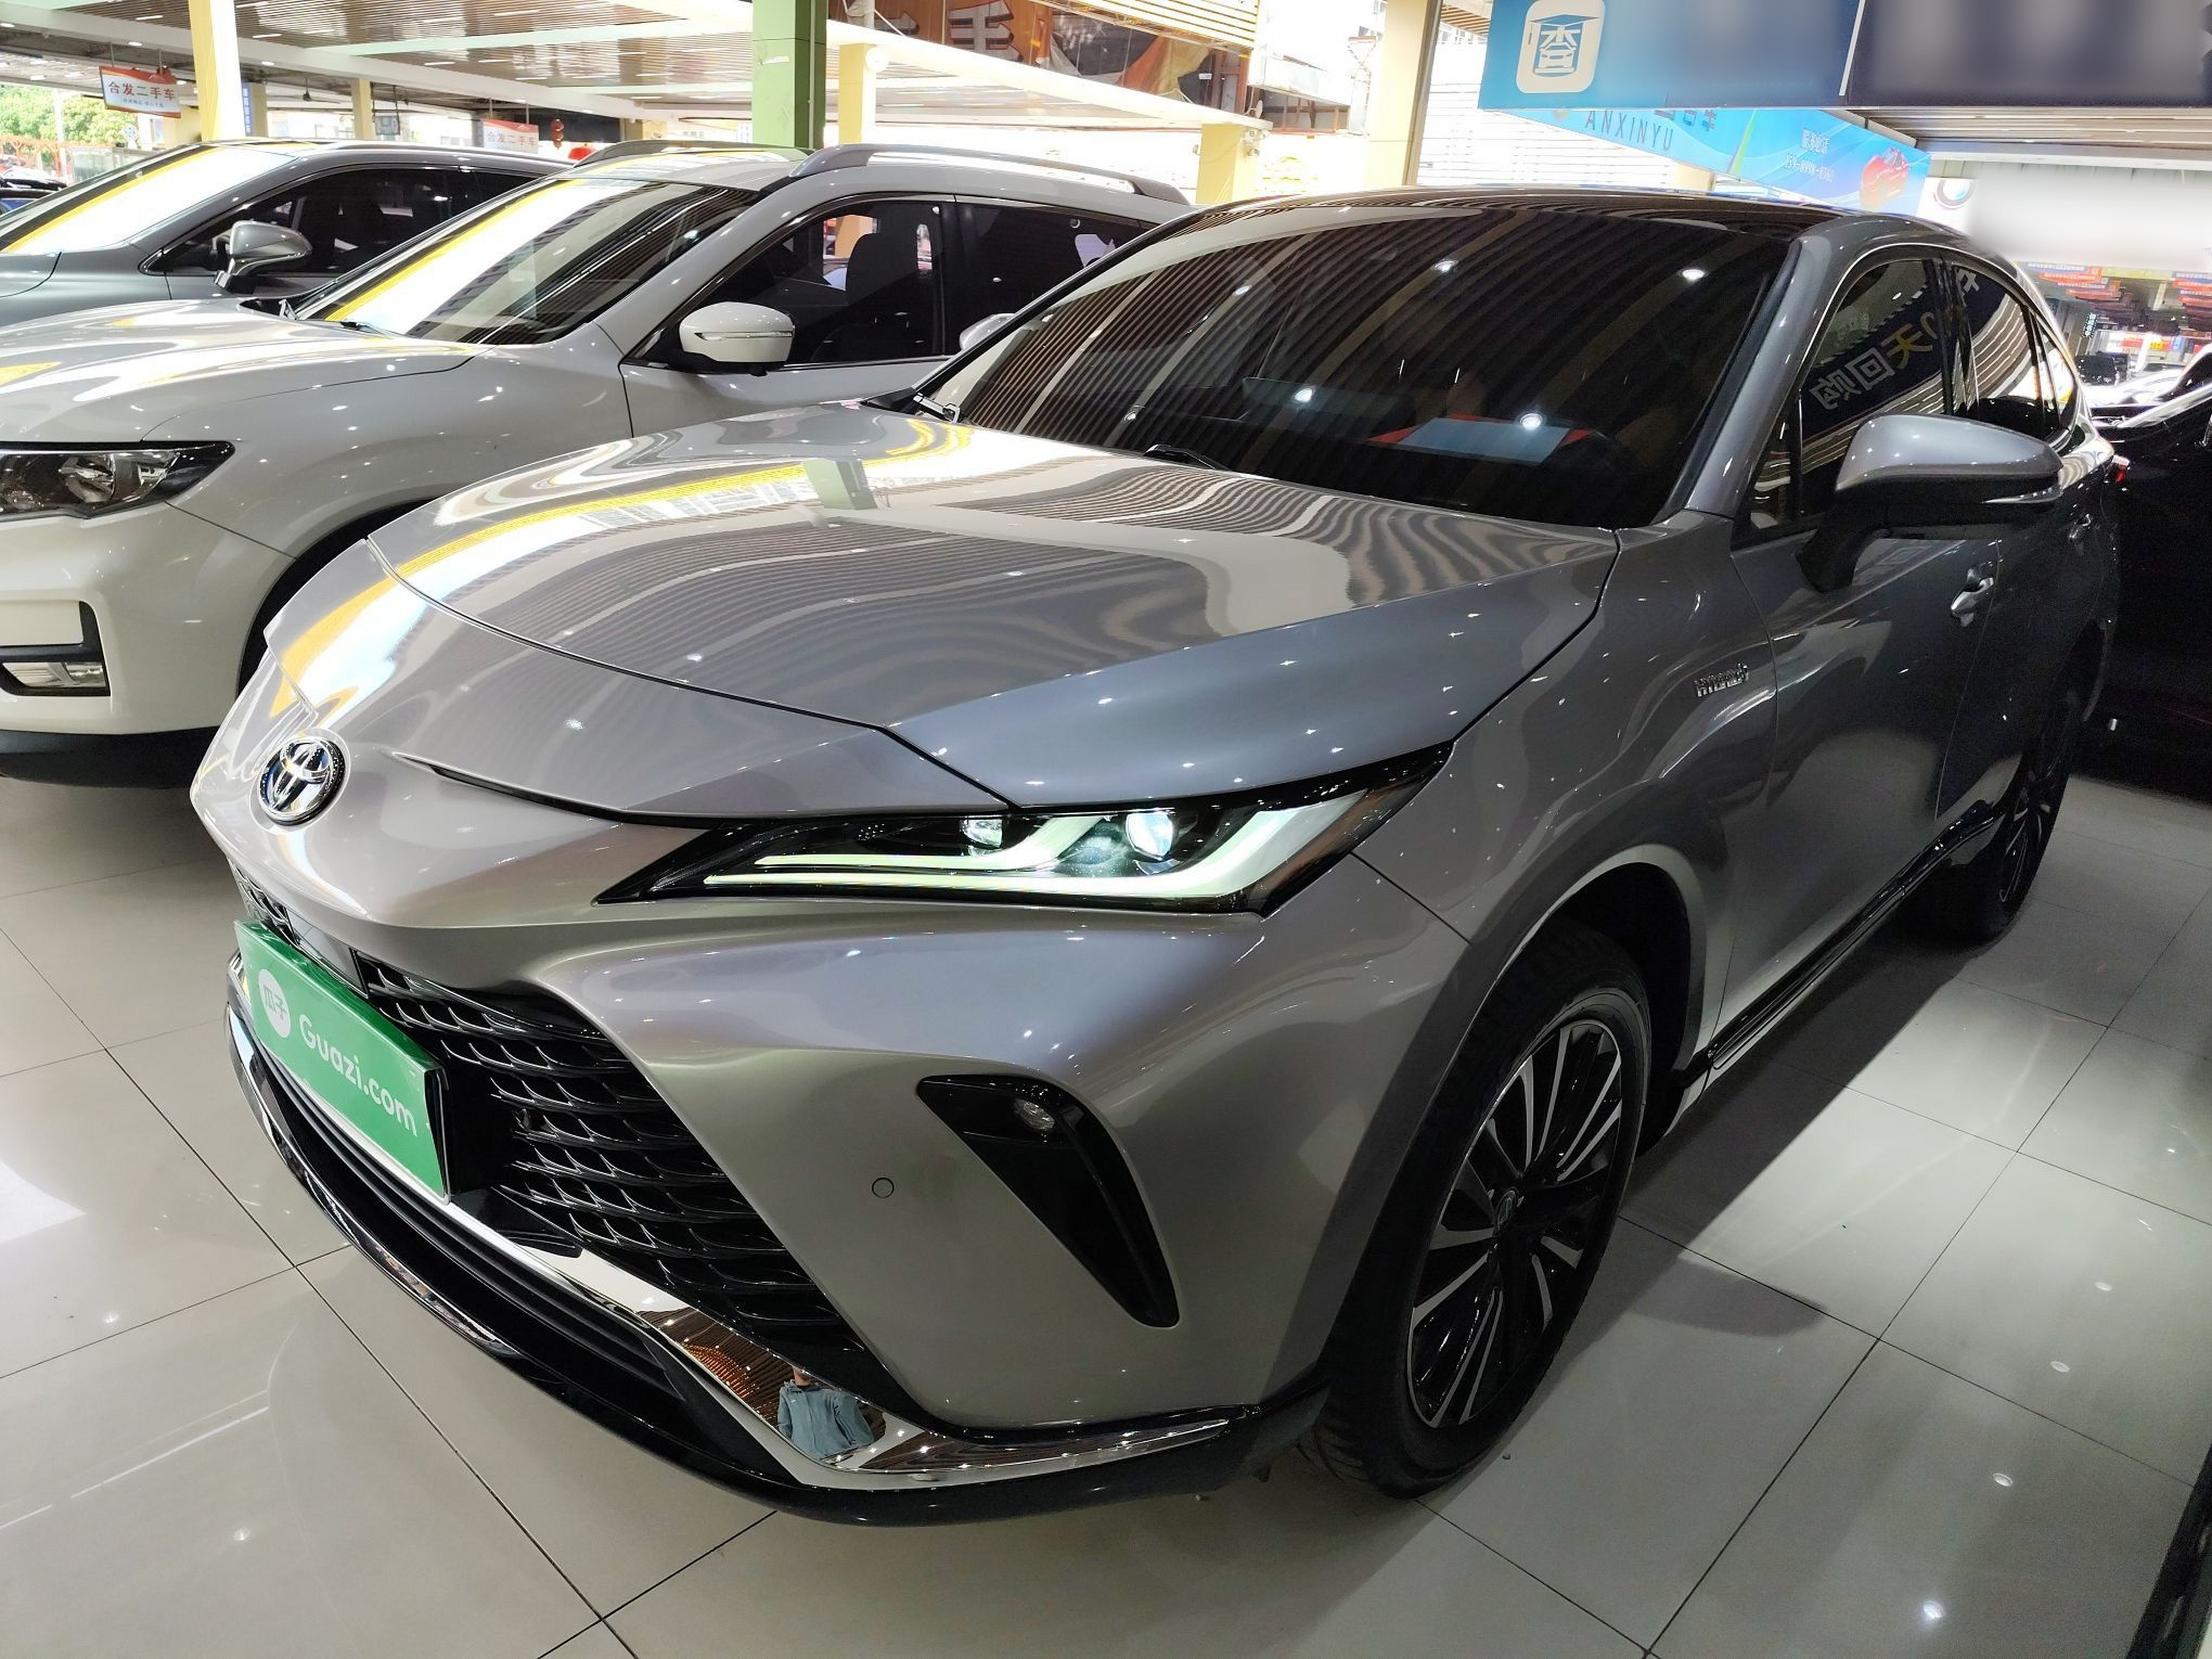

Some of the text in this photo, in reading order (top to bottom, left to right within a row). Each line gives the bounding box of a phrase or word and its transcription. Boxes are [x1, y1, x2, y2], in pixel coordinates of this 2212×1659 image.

[108, 81, 175, 100] 合发二手车
[1585, 110, 1673, 151] ANXINYU
[299, 1014, 418, 1137] Guazi.com
